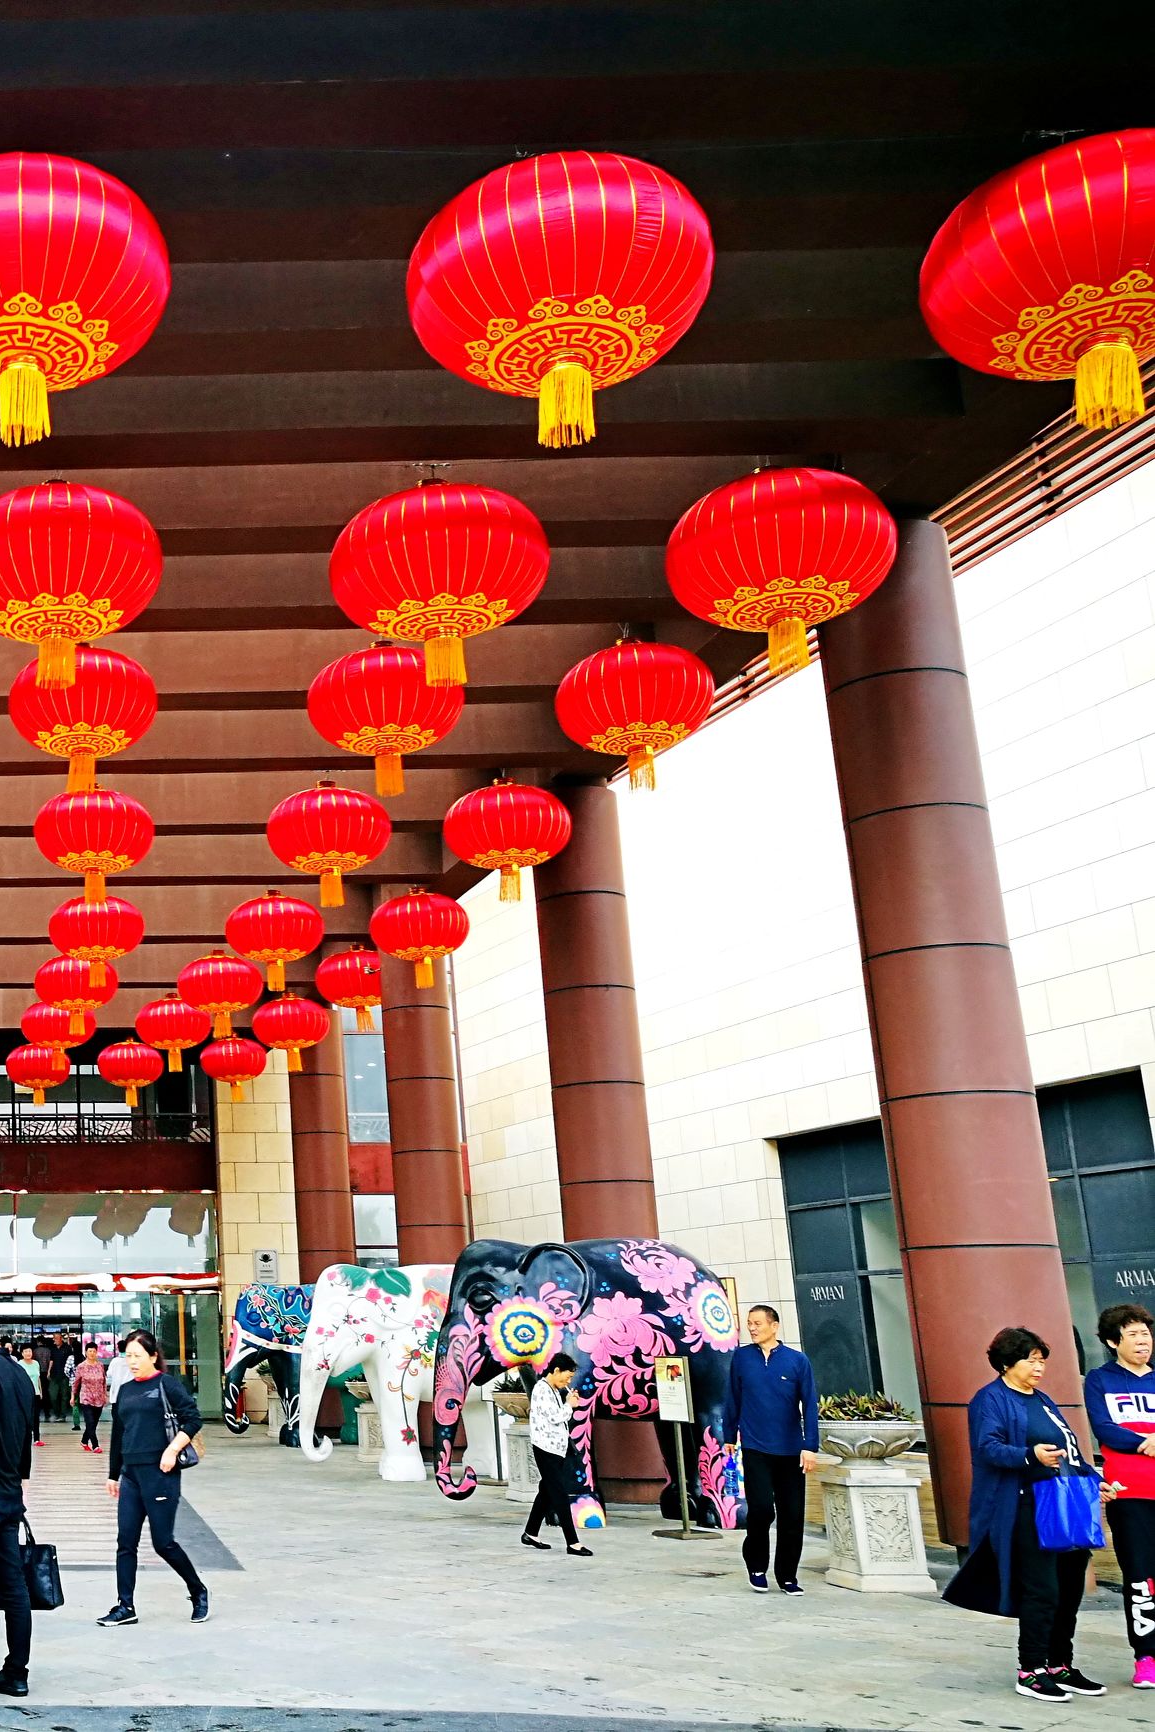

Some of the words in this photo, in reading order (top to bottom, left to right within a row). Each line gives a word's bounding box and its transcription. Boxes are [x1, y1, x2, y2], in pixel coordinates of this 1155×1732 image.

[1116, 1269, 1155, 1288] ARMA
[810, 1285, 845, 1301] ARMANI
[1114, 1395, 1155, 1413] FIL
[1131, 1578, 1155, 1637] FILA
